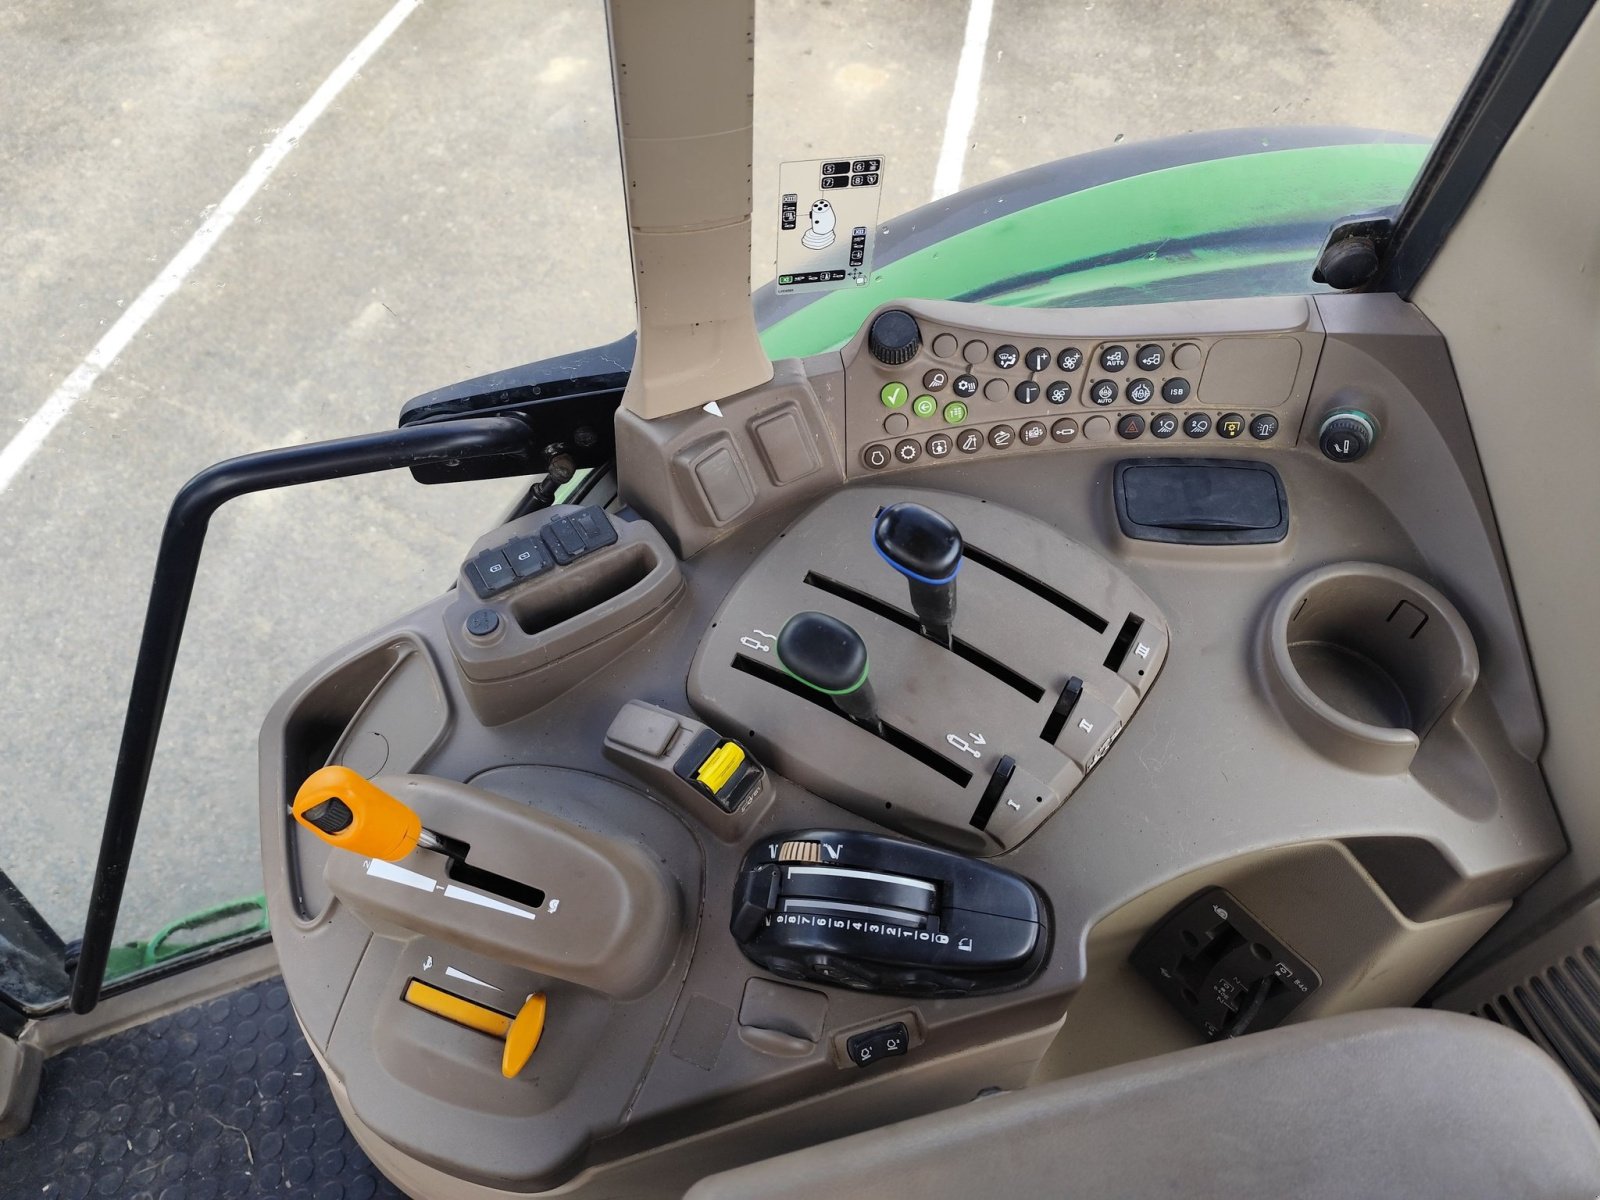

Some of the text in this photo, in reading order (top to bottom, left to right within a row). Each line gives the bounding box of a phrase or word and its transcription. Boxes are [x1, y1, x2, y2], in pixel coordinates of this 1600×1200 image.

[826, 164, 833, 172] 5
[854, 176, 861, 184] 8
[1170, 388, 1184, 396] ISB
[1191, 420, 1197, 428] 2
[1134, 642, 1151, 659] III
[1078, 718, 1094, 734] II
[788, 915, 797, 924] 8
[801, 916, 811, 925] 7
[816, 918, 827, 926] 6
[833, 920, 845, 928] 5
[852, 922, 863, 930] 4
[869, 925, 880, 933] 3
[886, 927, 896, 936] 2
[903, 930, 913, 938] 1
[919, 932, 930, 941] 0
